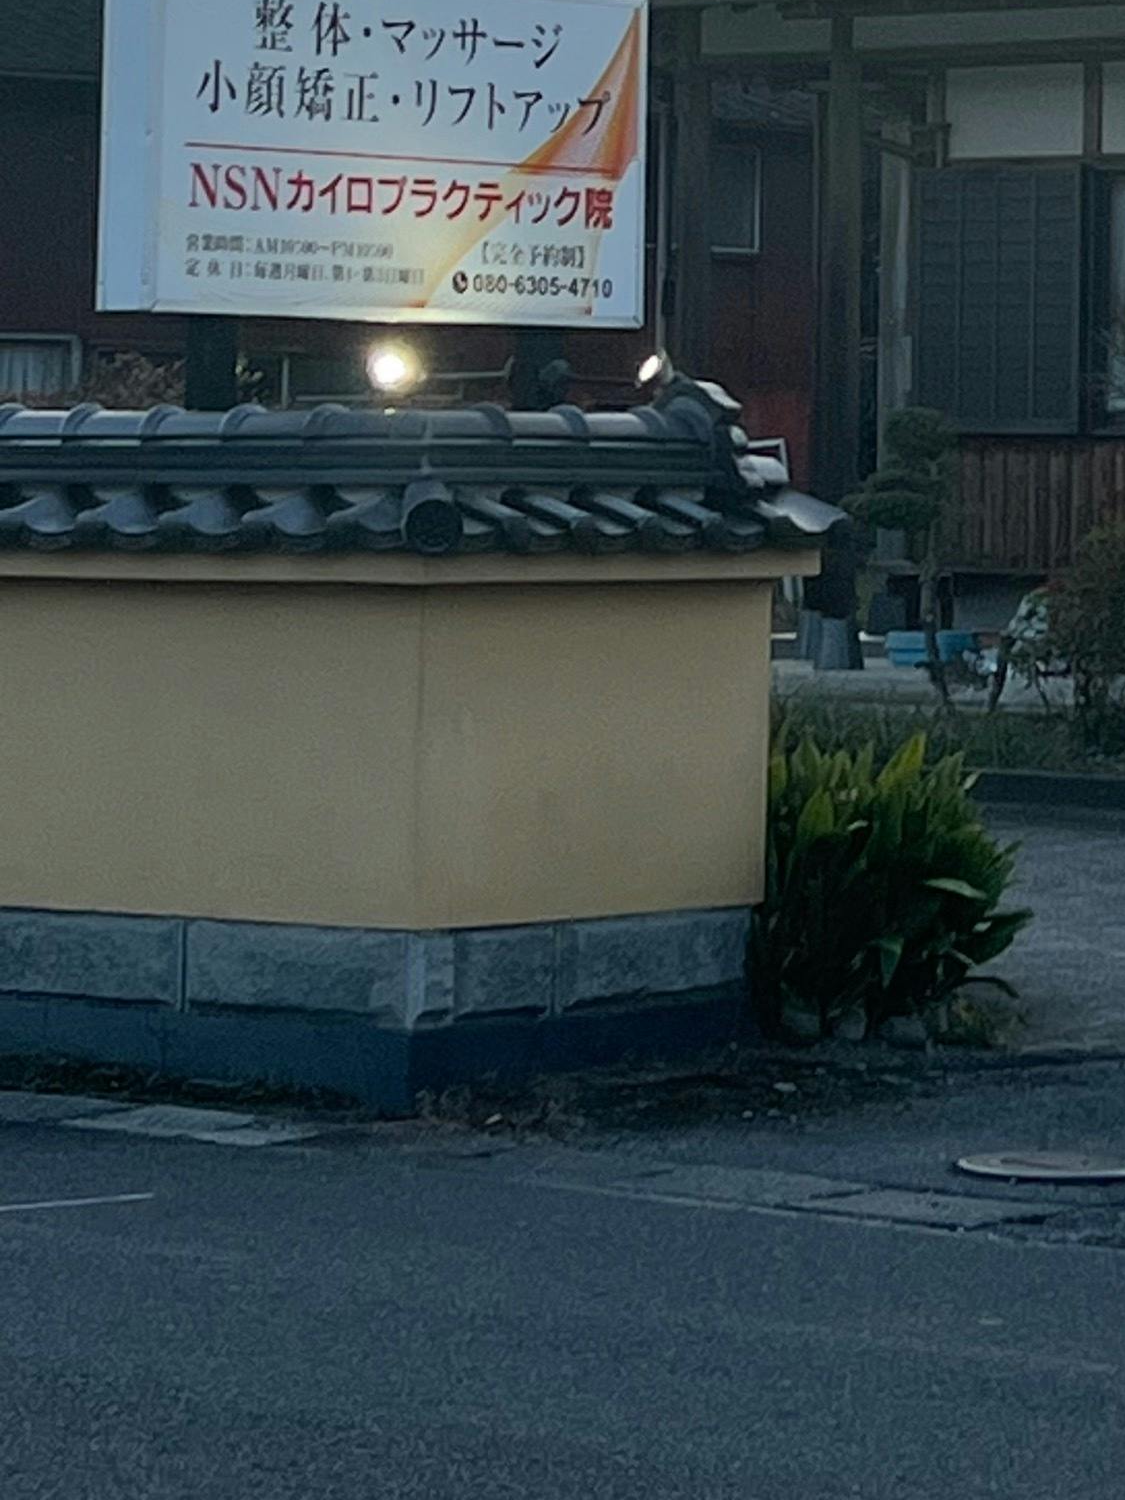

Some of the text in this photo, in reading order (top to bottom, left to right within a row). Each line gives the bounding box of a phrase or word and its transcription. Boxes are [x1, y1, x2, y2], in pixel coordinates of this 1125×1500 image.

[188, 162, 614, 230] NSNカイロプラクティック院
[472, 273, 614, 299] 080-6305-4710
